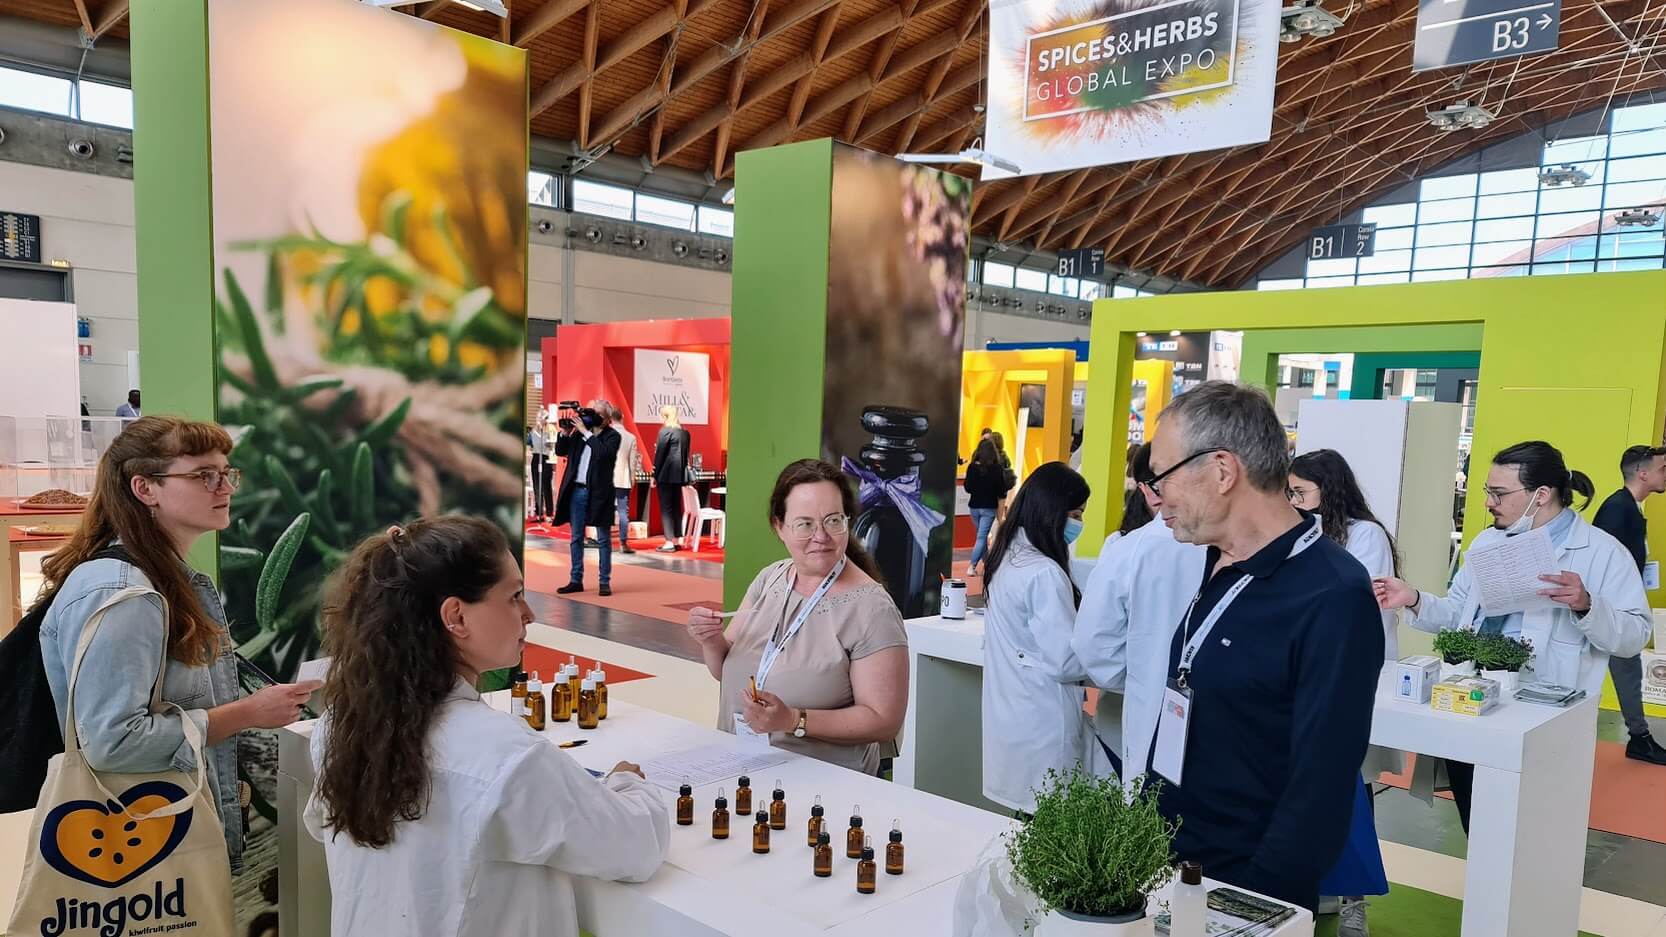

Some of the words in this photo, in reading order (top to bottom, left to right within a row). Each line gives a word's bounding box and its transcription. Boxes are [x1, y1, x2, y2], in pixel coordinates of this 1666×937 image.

[1038, 12, 1218, 71] SPICES&HERBS
[1492, 17, 1530, 52] B3
[1037, 66, 1132, 100] GLOBAL
[1144, 48, 1215, 81] EXPO
[1312, 236, 1333, 258] B1
[1356, 241, 1365, 255] 2
[1059, 257, 1074, 276] B1
[1092, 262, 1097, 274] 1
[40, 878, 187, 937] Jingold
[129, 925, 165, 936] kiwifruit
[166, 920, 197, 932] passion
